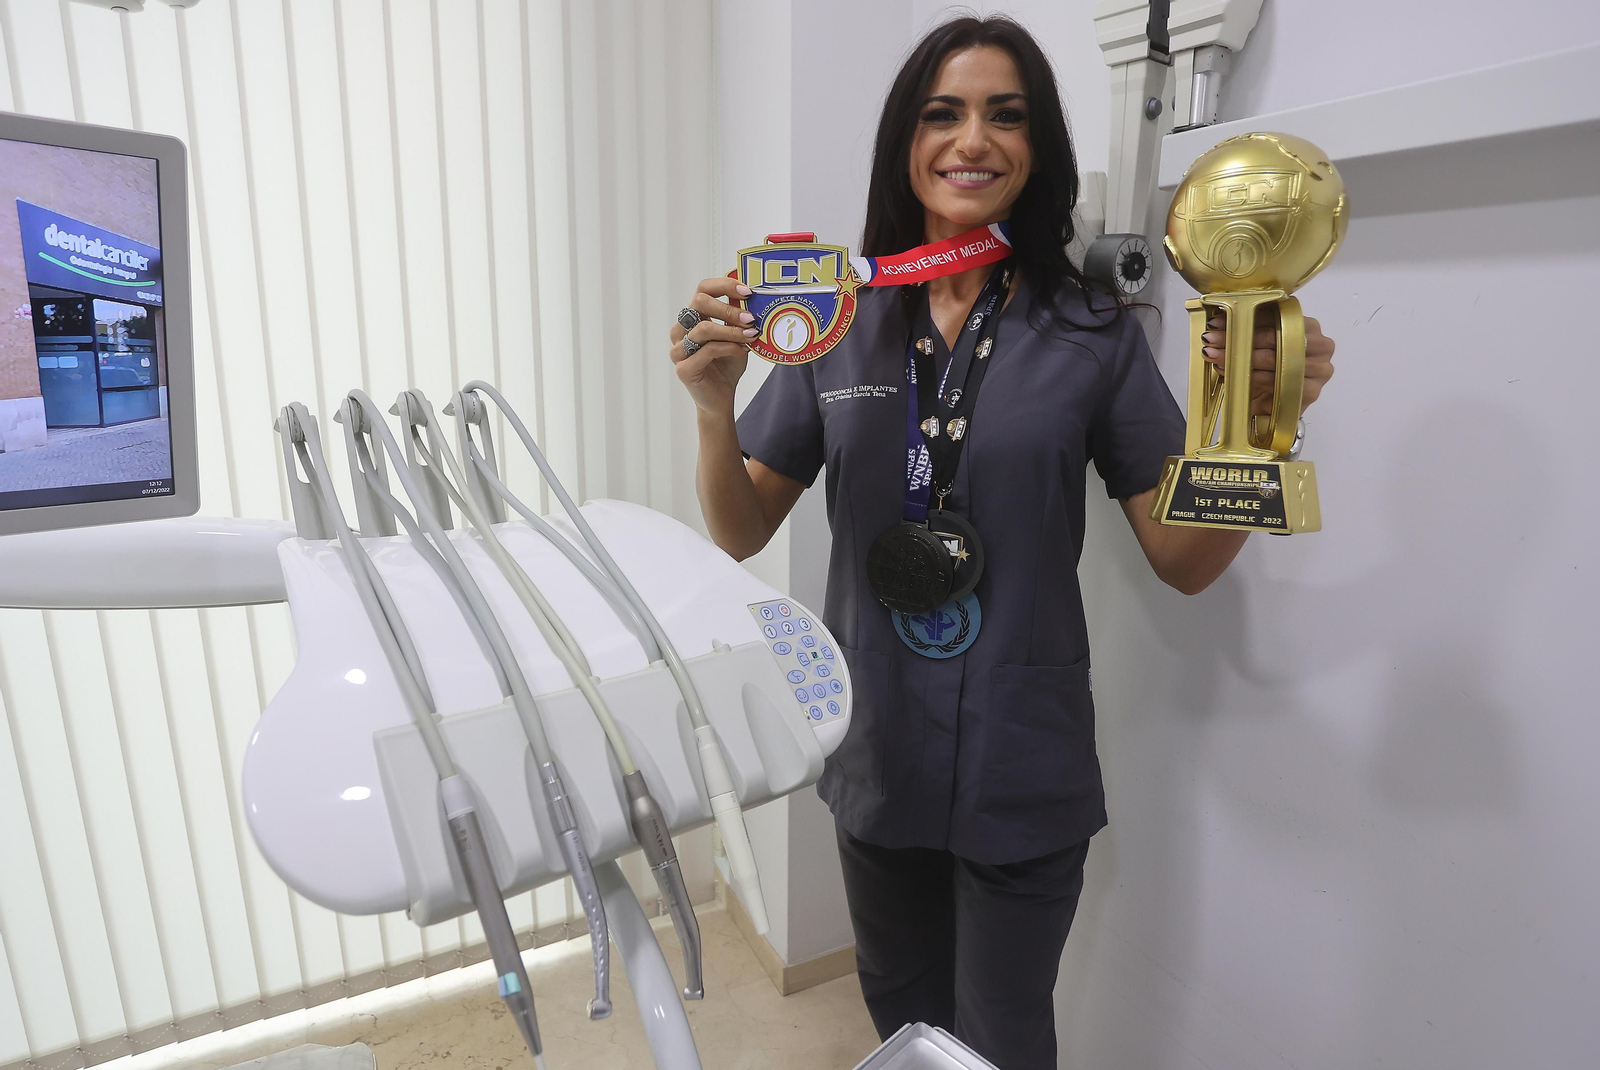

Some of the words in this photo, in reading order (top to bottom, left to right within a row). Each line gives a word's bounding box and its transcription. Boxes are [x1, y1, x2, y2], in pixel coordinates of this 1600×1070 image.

[1190, 177, 1291, 215] ICN
[44, 223, 149, 271] dentalcanciller
[881, 250, 958, 276] ACHIEVEMENT
[959, 237, 999, 258] MEDAL
[746, 252, 838, 288] ICN
[761, 295, 796, 316] COMPETE
[797, 296, 825, 325] NATURAL
[760, 349, 789, 362] MODEL
[792, 347, 822, 362] WORLD
[824, 310, 852, 350] ALLIANCE
[859, 385, 898, 393] IMPLANTES
[1190, 467, 1268, 483] WORLD
[142, 487, 170, 495] 07/12/2022
[1194, 497, 1212, 507] 1ST
[1218, 498, 1260, 510] PLACE
[1171, 510, 1195, 518] PRAGUE
[1201, 512, 1223, 520] CZECH
[1224, 514, 1255, 523] REPUBLIC
[1262, 516, 1282, 525] 2022
[764, 609, 770, 618] P
[785, 623, 792, 633] 2
[801, 620, 808, 629] 3
